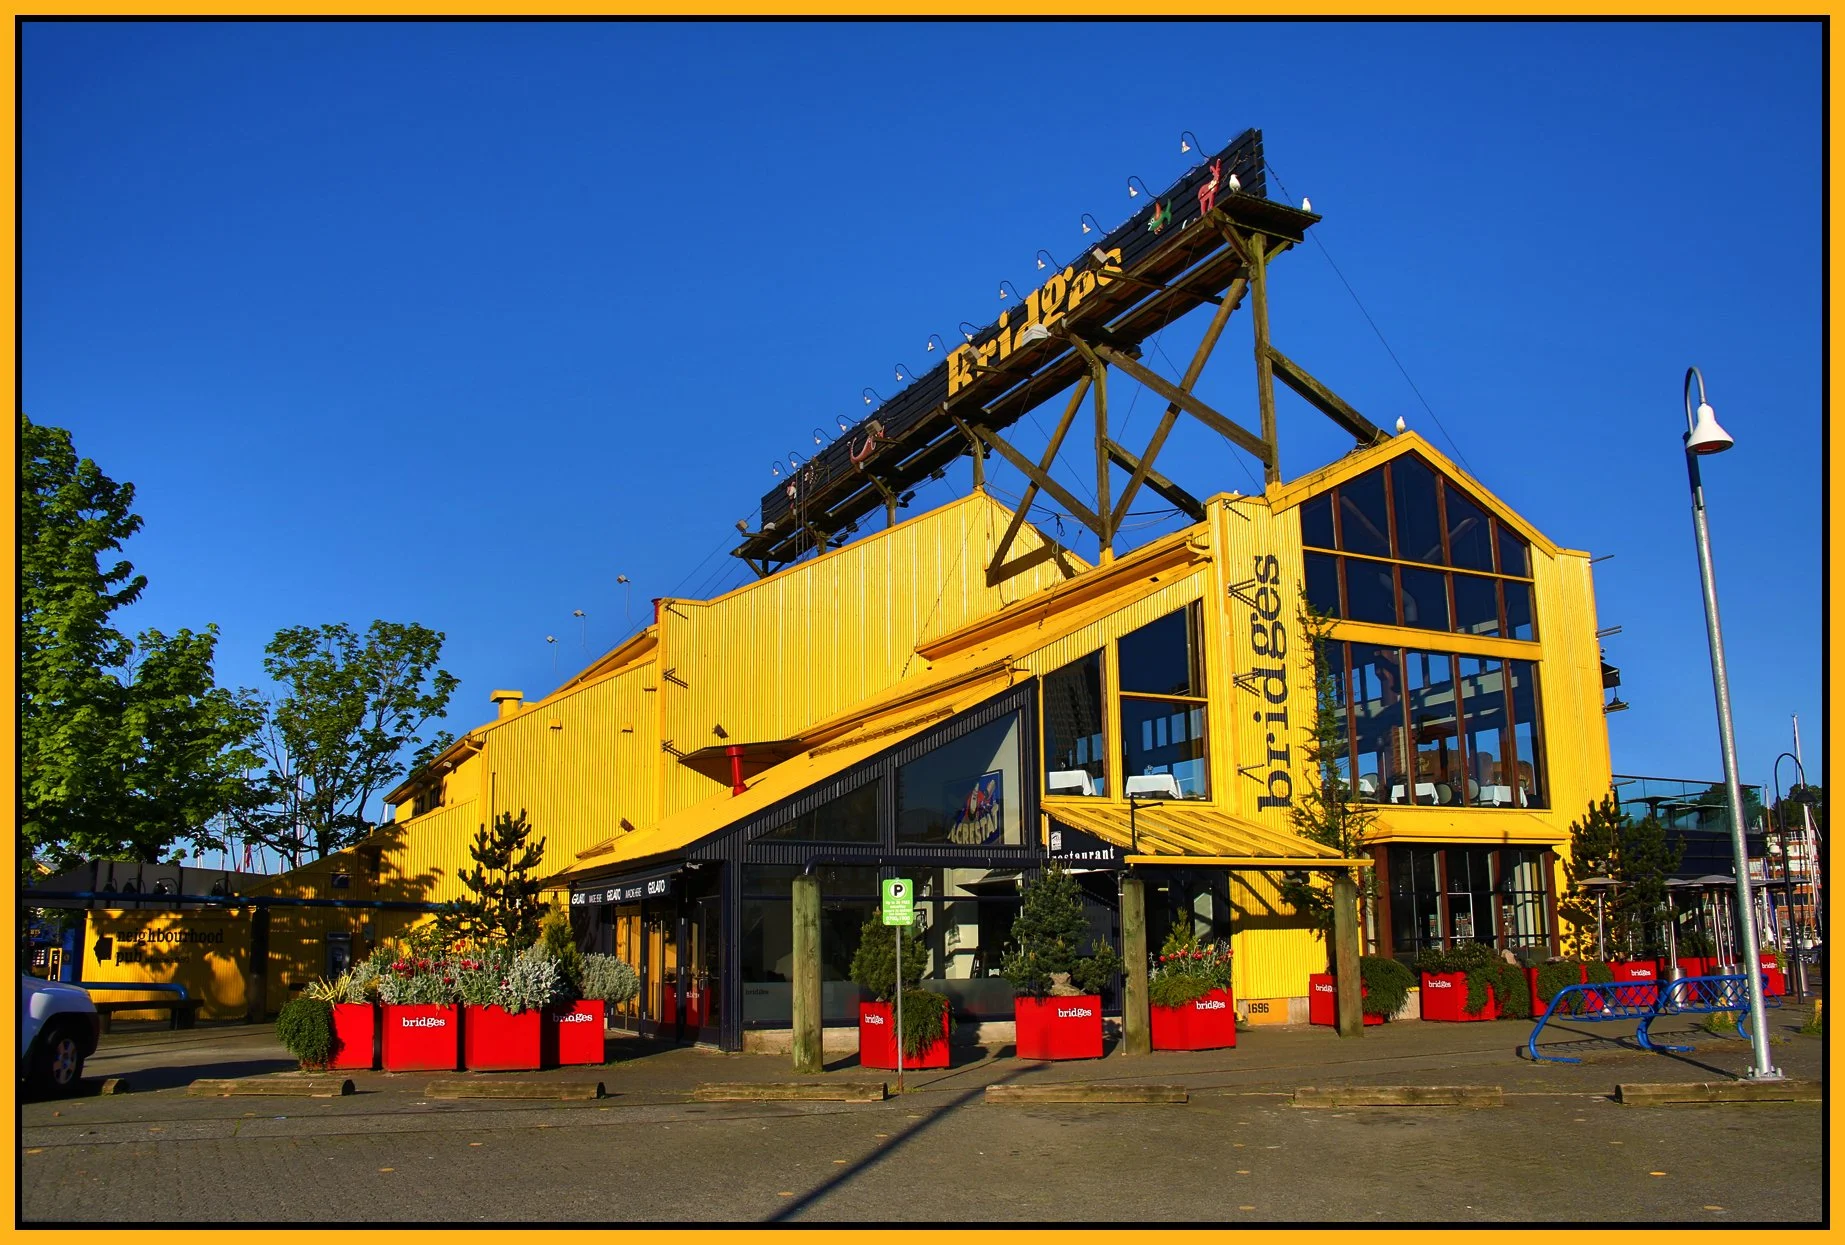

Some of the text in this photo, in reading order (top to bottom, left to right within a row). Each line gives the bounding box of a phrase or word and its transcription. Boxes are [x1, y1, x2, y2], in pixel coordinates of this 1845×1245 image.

[1250, 554, 1293, 813] bridges
[1051, 845, 1115, 861] taurant
[647, 879, 665, 895] GELATO
[893, 884, 903, 896] P
[116, 928, 224, 946] neighbourhood
[115, 948, 143, 967] pub
[1428, 980, 1451, 989] bridges
[1196, 1000, 1226, 1010] bridges
[1247, 1002, 1270, 1014] 1696
[1057, 1007, 1092, 1018] bridges
[402, 1016, 445, 1028] bridges
[864, 1013, 884, 1026] bridges
